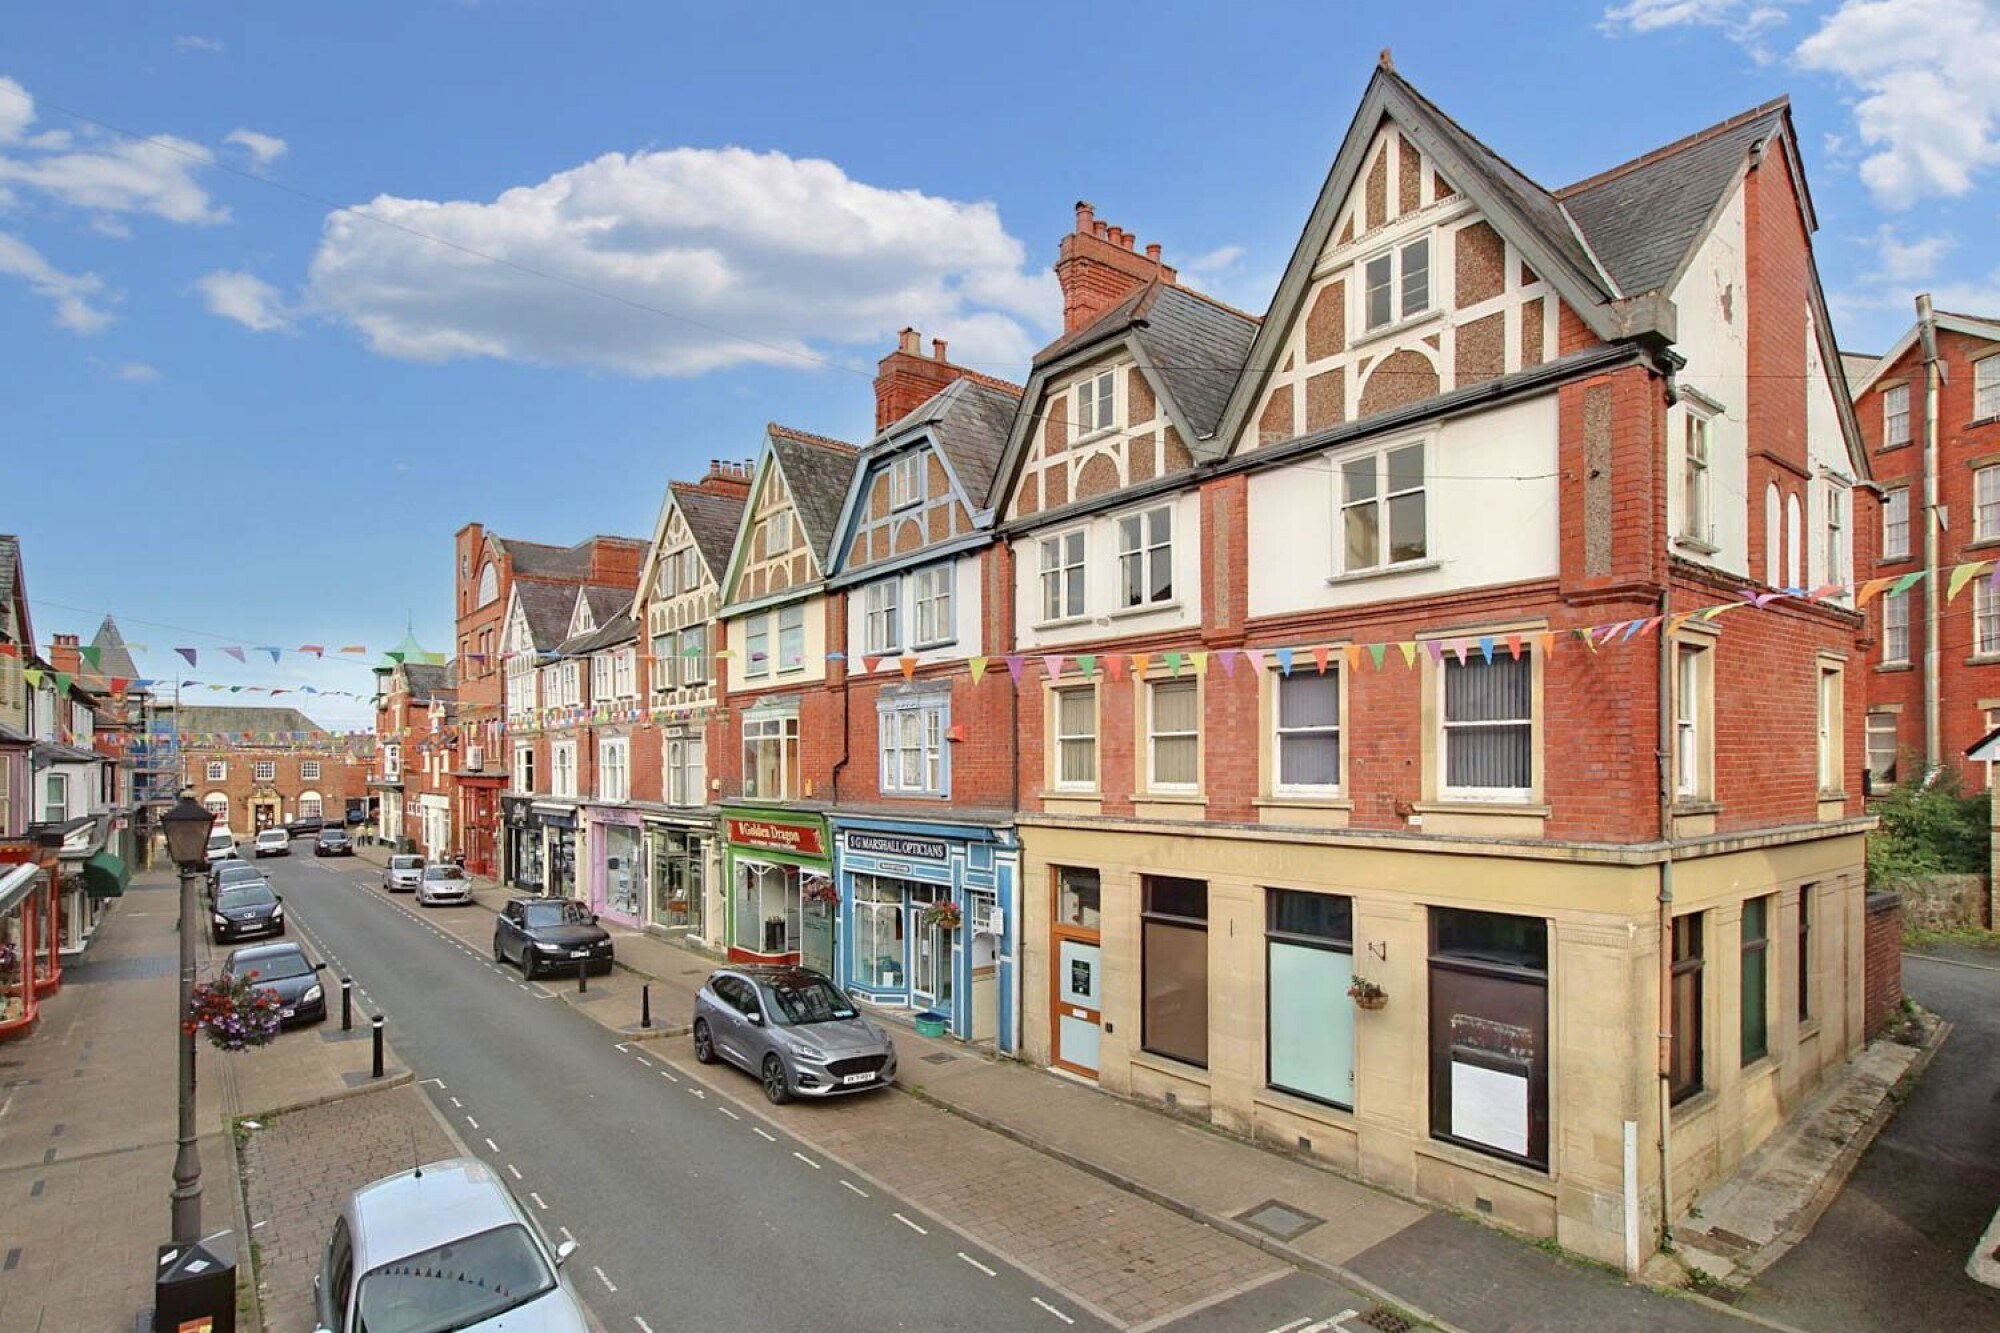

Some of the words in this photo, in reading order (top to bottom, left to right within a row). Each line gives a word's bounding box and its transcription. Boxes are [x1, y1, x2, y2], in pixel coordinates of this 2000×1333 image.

[744, 823, 769, 838] Golden
[770, 825, 800, 844] Dragon
[862, 837, 901, 853] MARSHALL
[902, 841, 944, 858] OPTICIANS
